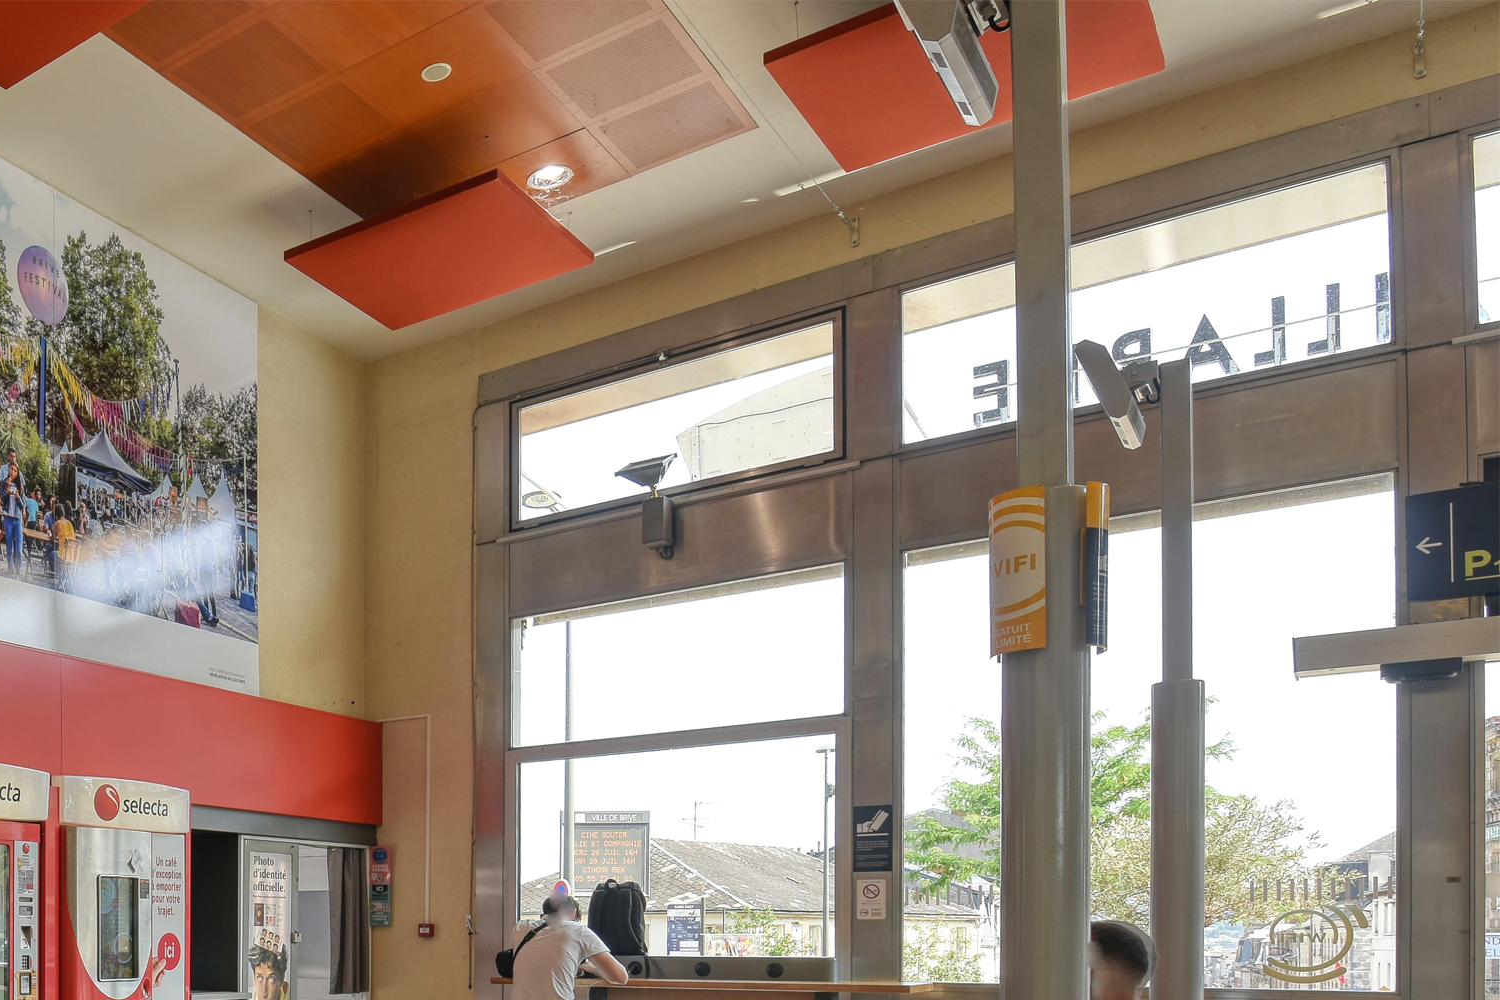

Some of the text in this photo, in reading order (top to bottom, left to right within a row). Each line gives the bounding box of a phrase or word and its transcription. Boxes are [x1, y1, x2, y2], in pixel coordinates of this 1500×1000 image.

[32, 256, 60, 278] BRIVE
[24, 272, 66, 303] FESTIVAL
[995, 622, 1032, 638] RATUIT
[995, 631, 1032, 649] LIMITÉ
[122, 797, 168, 817] selecta
[156, 856, 177, 868] Un café
[254, 856, 274, 866] Photo
[253, 868, 287, 880] d'identité
[156, 883, 181, 893] emporter
[253, 881, 286, 892] officielle.
[152, 895, 180, 905] pour votre
[157, 906, 174, 918] trajet.
[164, 942, 175, 958] ici
